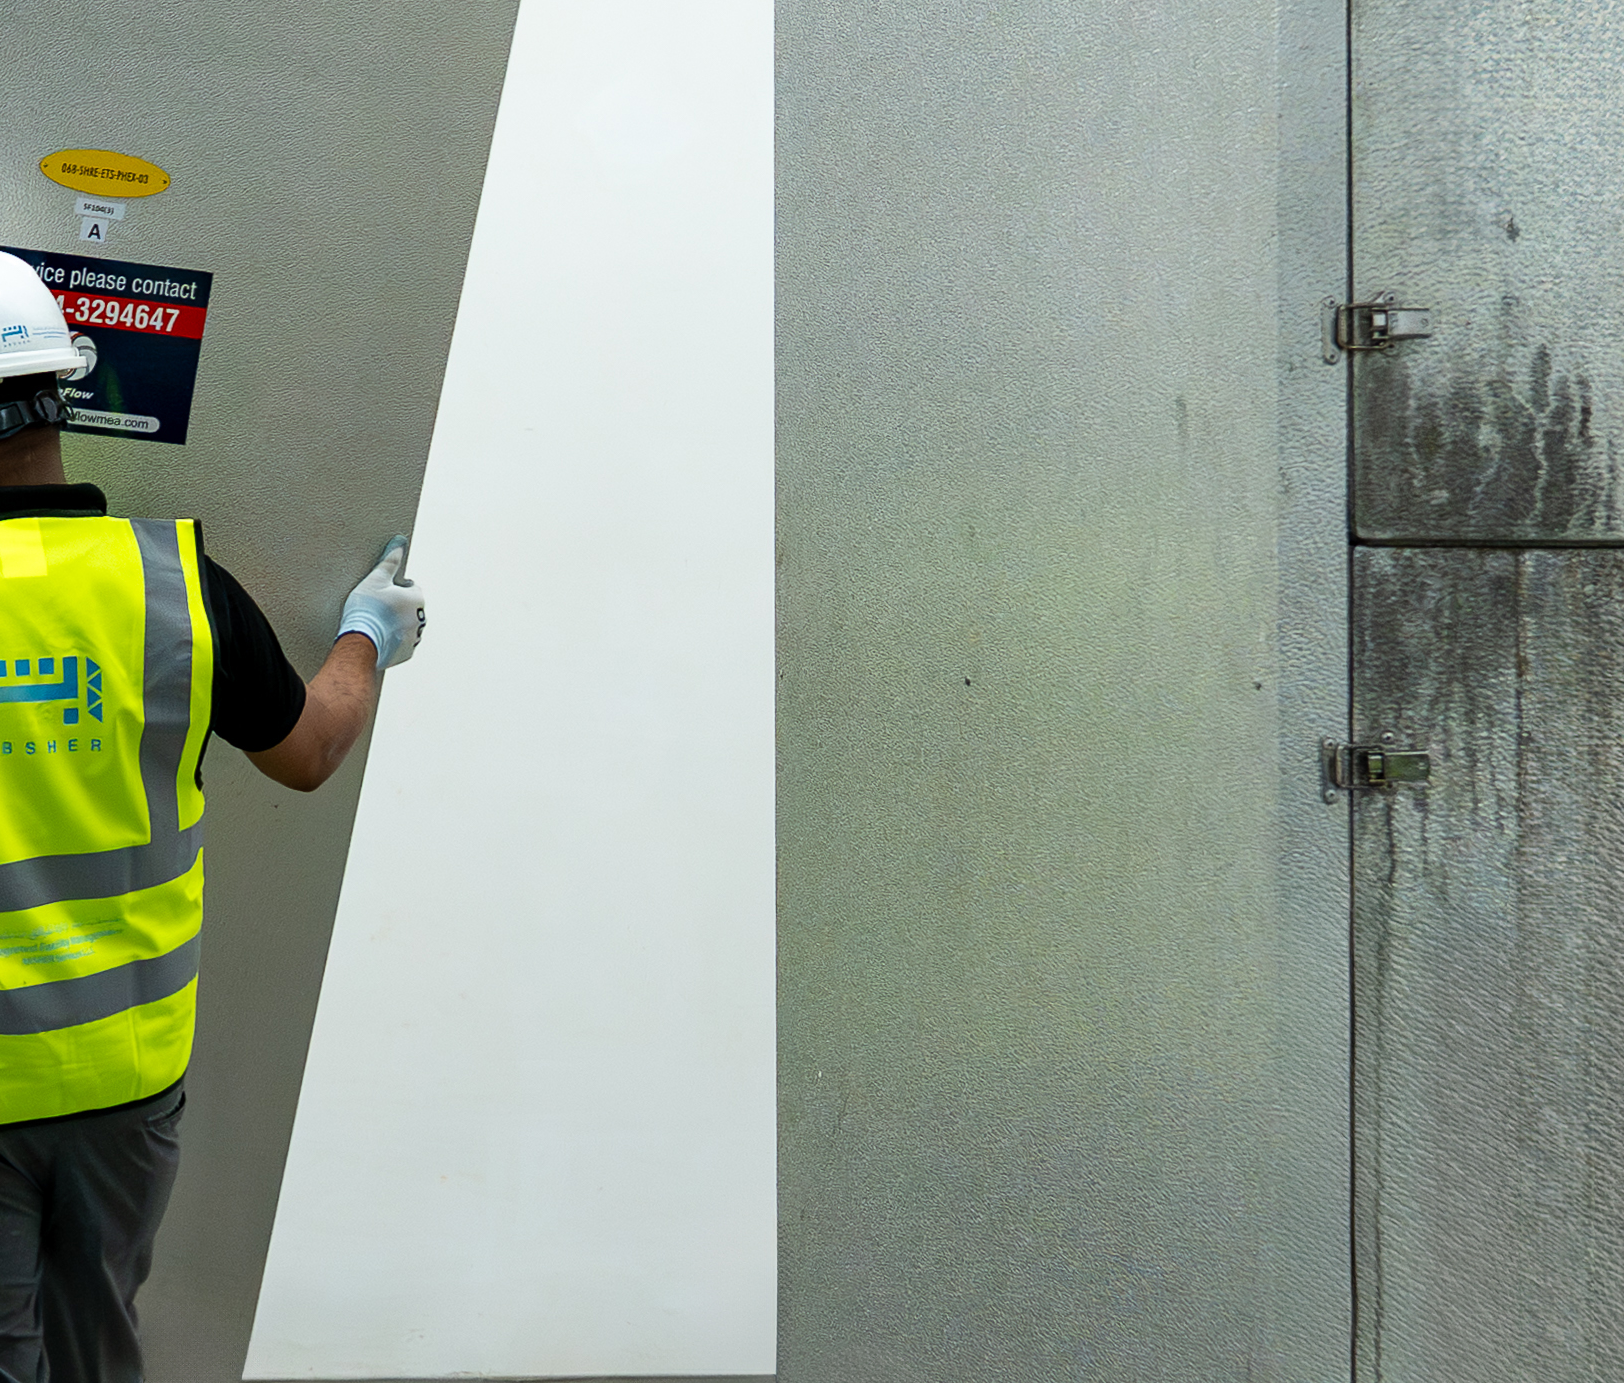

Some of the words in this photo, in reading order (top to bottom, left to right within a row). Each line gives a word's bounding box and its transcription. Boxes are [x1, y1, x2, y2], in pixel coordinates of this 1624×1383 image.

[88, 223, 101, 240] A
[69, 267, 127, 291] please
[131, 277, 198, 300] contact
